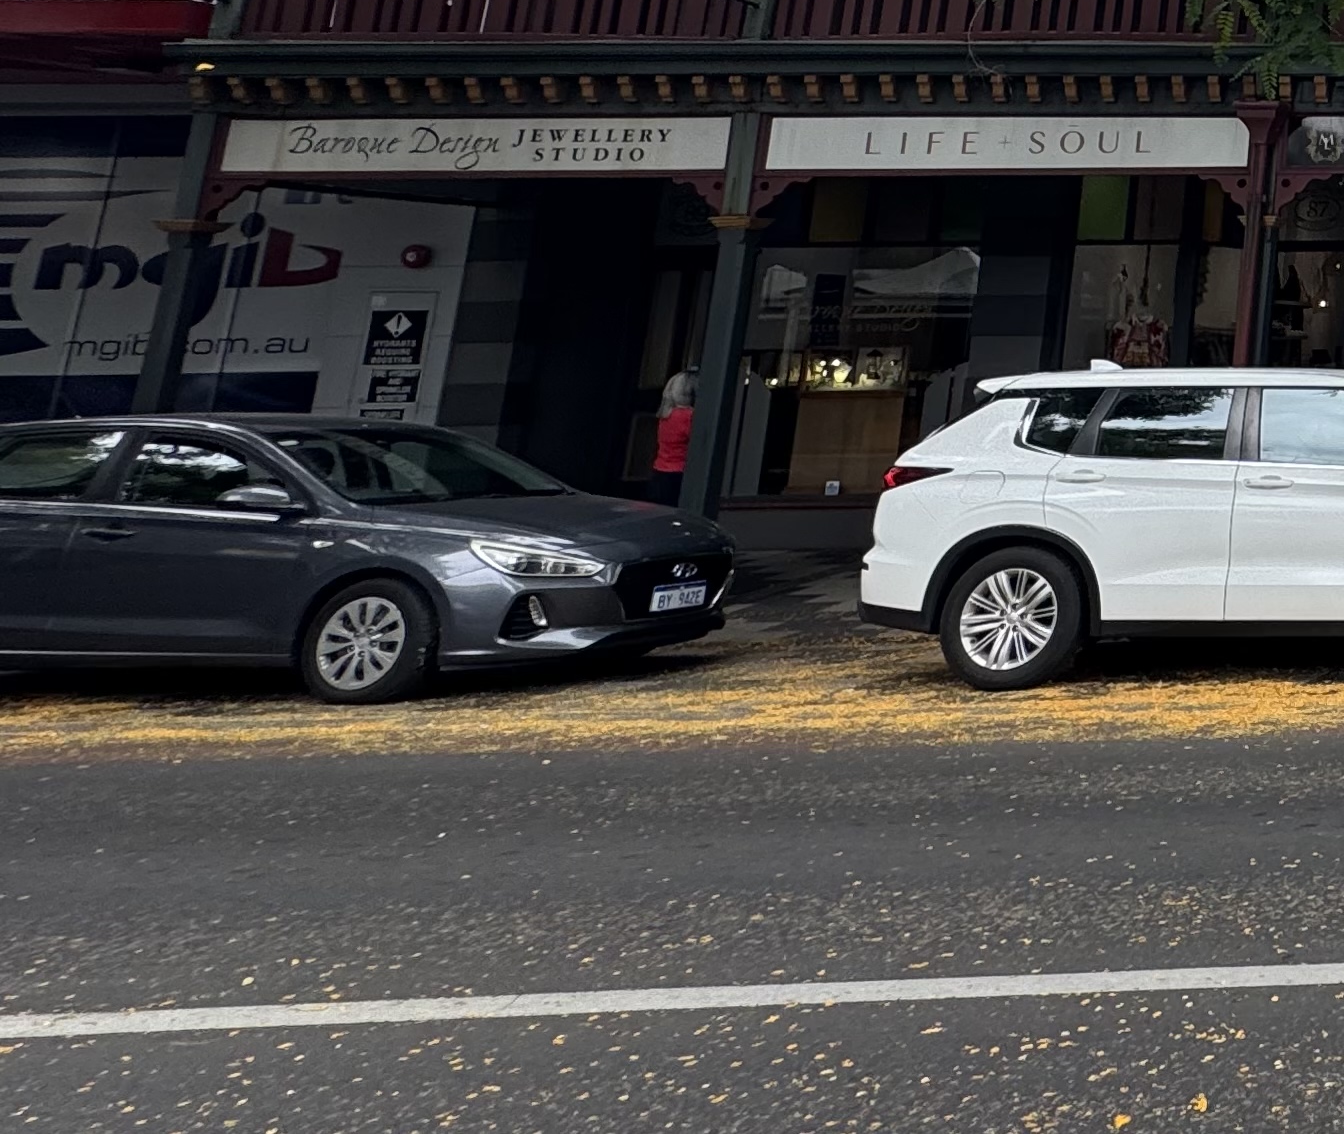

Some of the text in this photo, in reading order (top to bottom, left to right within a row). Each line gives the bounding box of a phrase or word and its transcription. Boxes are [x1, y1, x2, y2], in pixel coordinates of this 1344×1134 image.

[287, 122, 500, 170] Baroque Design
[513, 127, 674, 147] JEWELLERY
[864, 130, 981, 155] LIFE
[532, 146, 646, 163] STUDIO
[657, 593, 673, 609] BY
